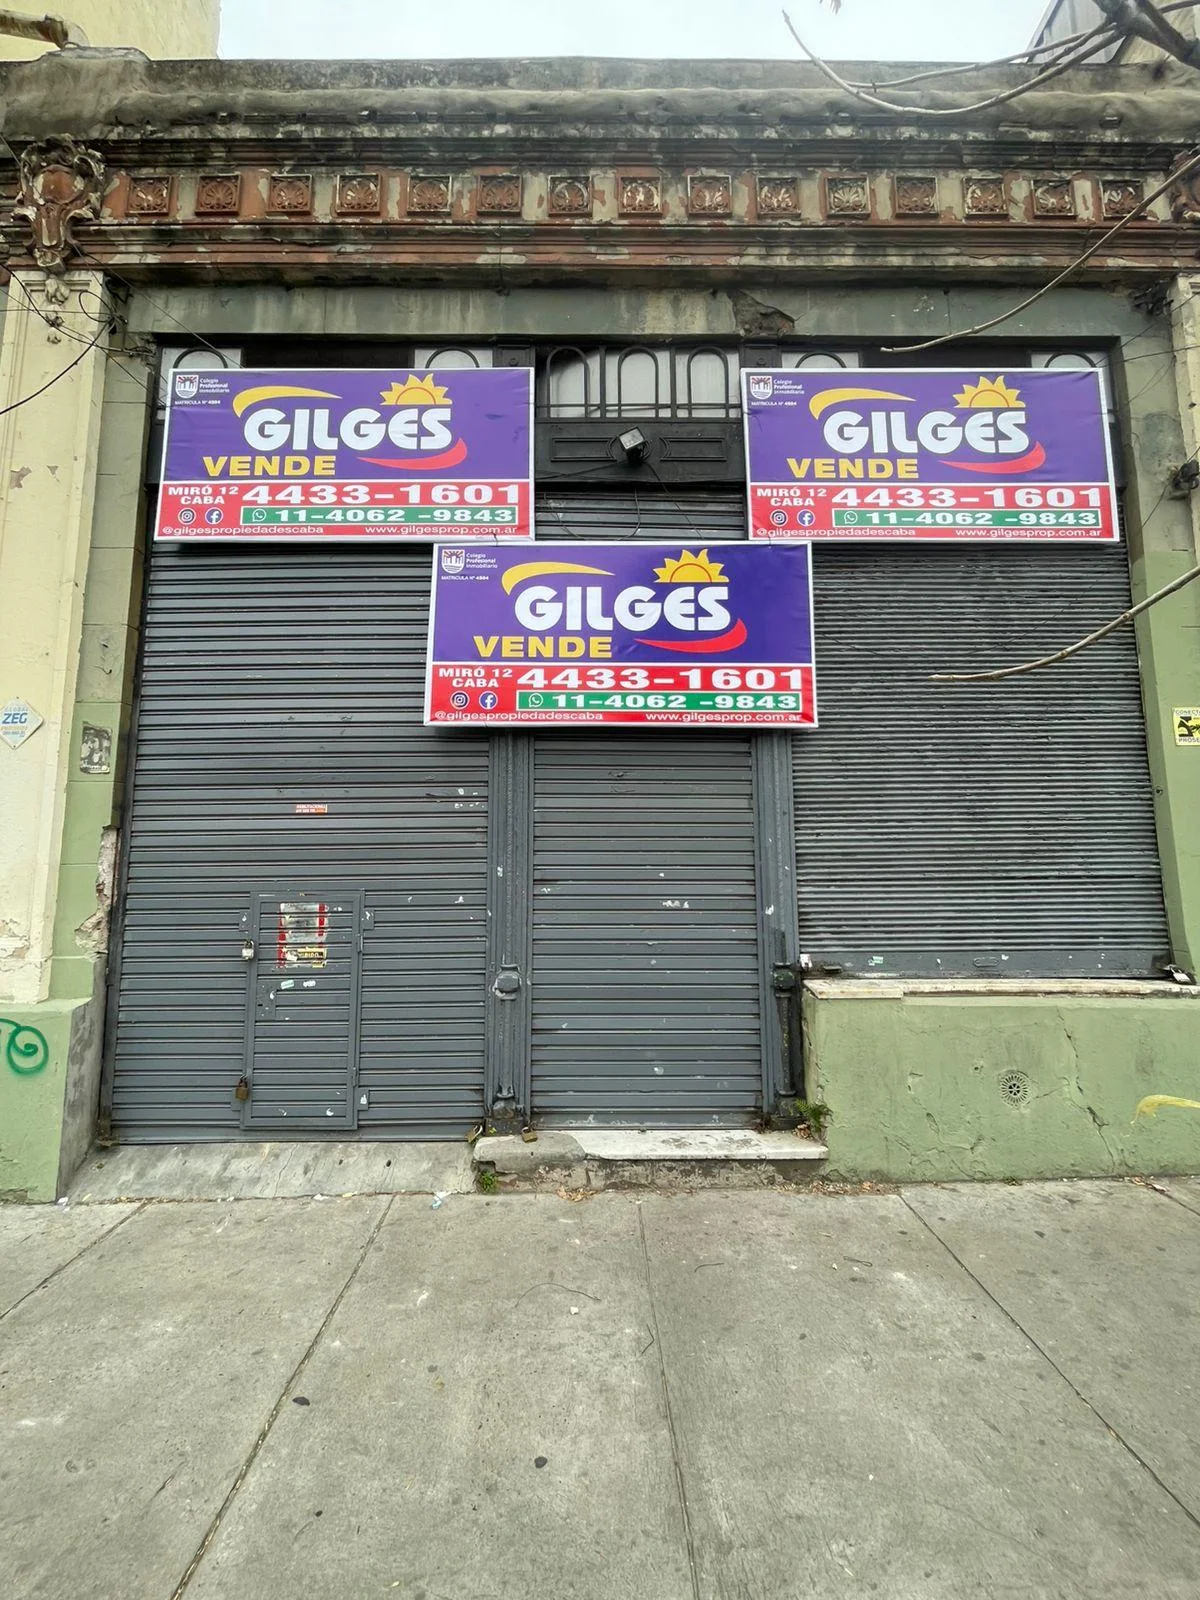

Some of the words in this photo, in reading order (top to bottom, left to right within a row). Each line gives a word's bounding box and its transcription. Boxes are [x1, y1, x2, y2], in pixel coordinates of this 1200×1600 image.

[243, 407, 453, 451] GILGES
[823, 411, 1030, 454] GILGES
[202, 455, 337, 476] VENDE
[786, 457, 919, 479] VENDE
[168, 484, 213, 495] MIRÓ
[219, 486, 239, 495] 12
[241, 484, 519, 504] 4433-1601
[756, 486, 799, 497] MIRÓ
[807, 488, 827, 497] 12
[180, 495, 225, 505] CABA
[770, 497, 815, 506] CABA
[831, 487, 1101, 507] 4433-1601
[162, 525, 324, 535] @gilgespropiedadescaba
[365, 525, 518, 535] www.gilgesprop.com.ar
[756, 527, 916, 538] @gilgespropiedadescaba
[955, 528, 1102, 538] www.gilgesprop.com.ar
[514, 584, 731, 631] GILGES
[473, 635, 612, 658] VENDE
[438, 666, 485, 678] MIRÓ
[492, 668, 513, 677] 12
[452, 677, 499, 688] CABA
[517, 668, 802, 689] 4433-1601
[2, 712, 28, 724] ZEG
[434, 710, 603, 721] @gilgespropiedadescaba
[645, 712, 802, 723] www.gilgesprop.com.ar
